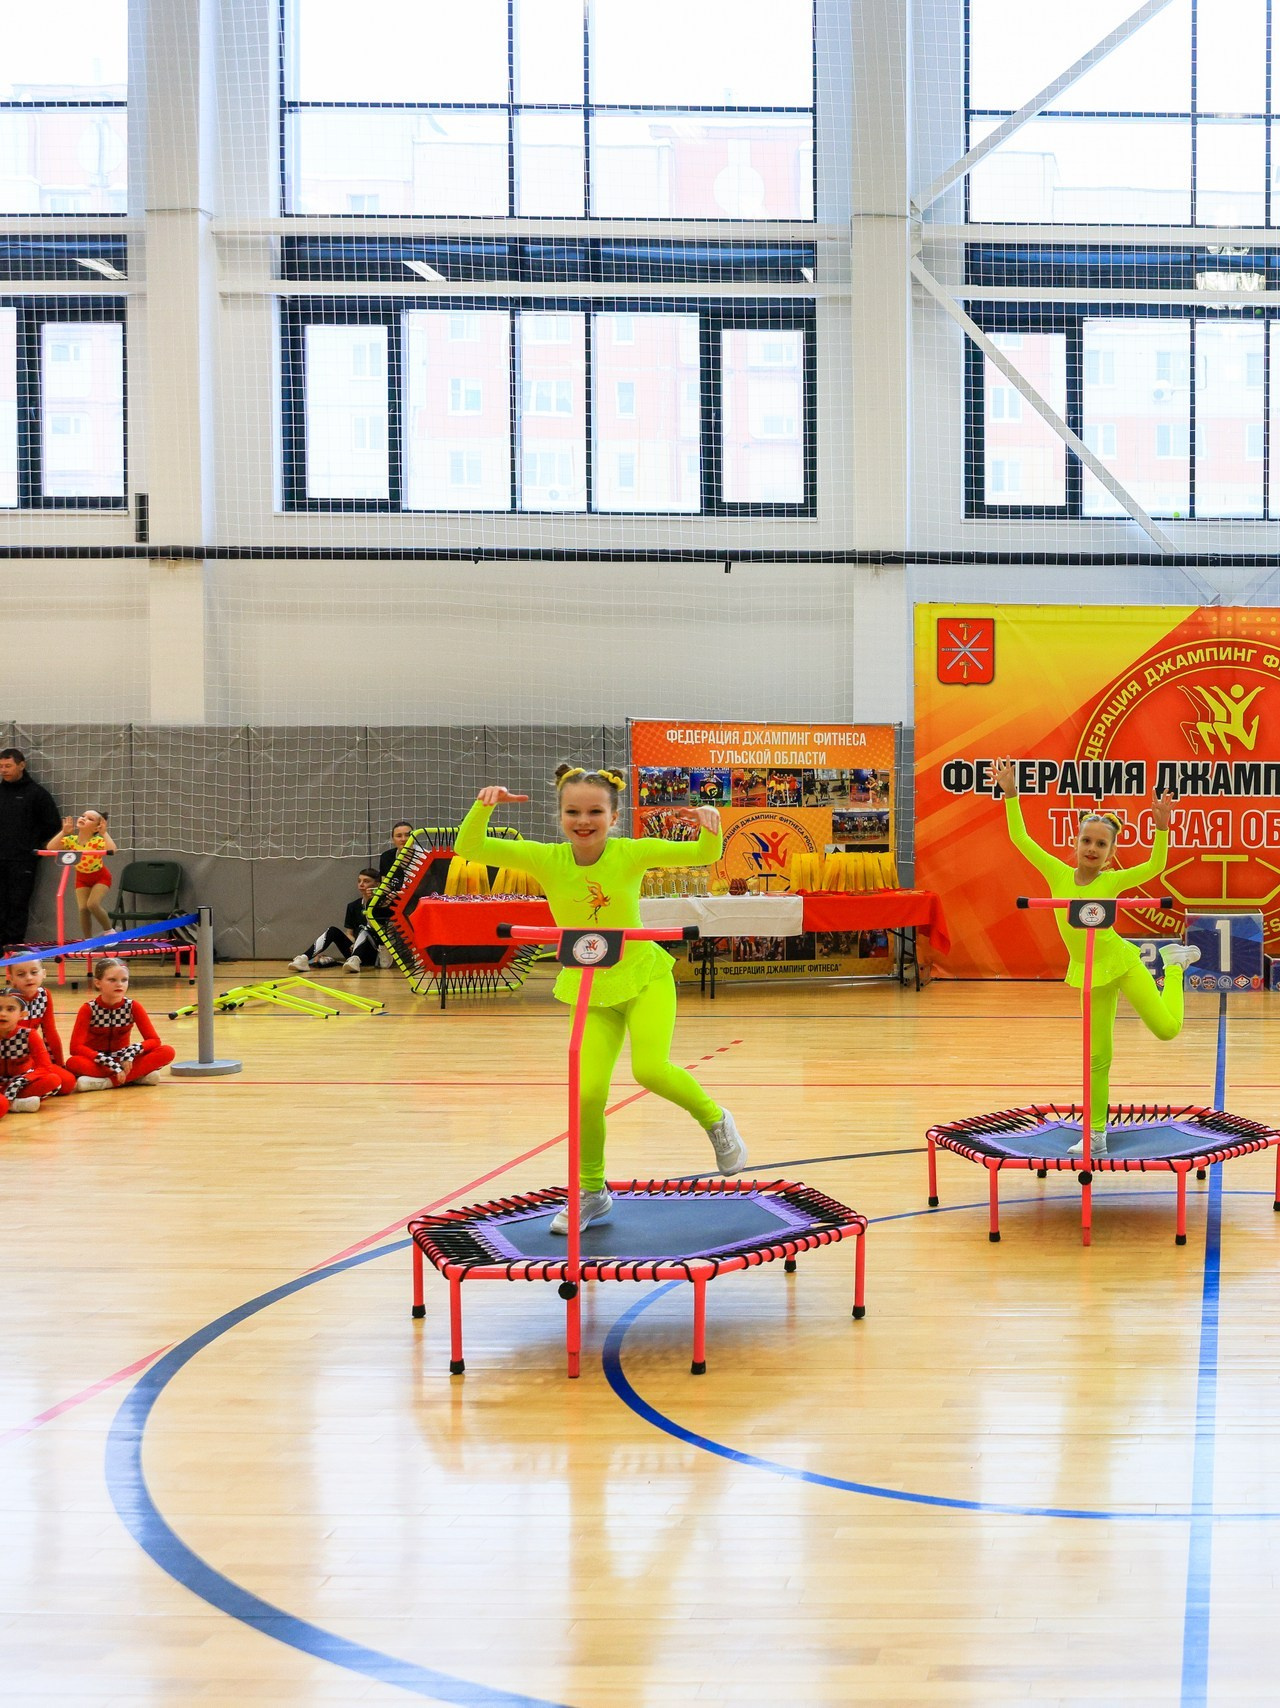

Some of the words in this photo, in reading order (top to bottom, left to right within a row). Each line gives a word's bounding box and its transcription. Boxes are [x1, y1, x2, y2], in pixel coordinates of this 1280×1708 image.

[1084, 680, 1142, 761] ДЕРАЦИЯ
[1143, 647, 1257, 686] ДЖАМПИНГ
[666, 729, 739, 745] ФЕДЕРАЦИЯ
[742, 730, 811, 746] ДЖАМПИНГ
[813, 731, 866, 746] ФИТНЕСА
[709, 748, 771, 765] ТУЛЬСКОЙ
[774, 750, 826, 765] ОБЛАСТИ
[740, 814, 777, 827] ДЖАМПИНГ
[779, 816, 804, 836] ФИТНЕСА
[1215, 919, 1231, 972] 1
[766, 964, 806, 975] ДЖАМПИНГ
